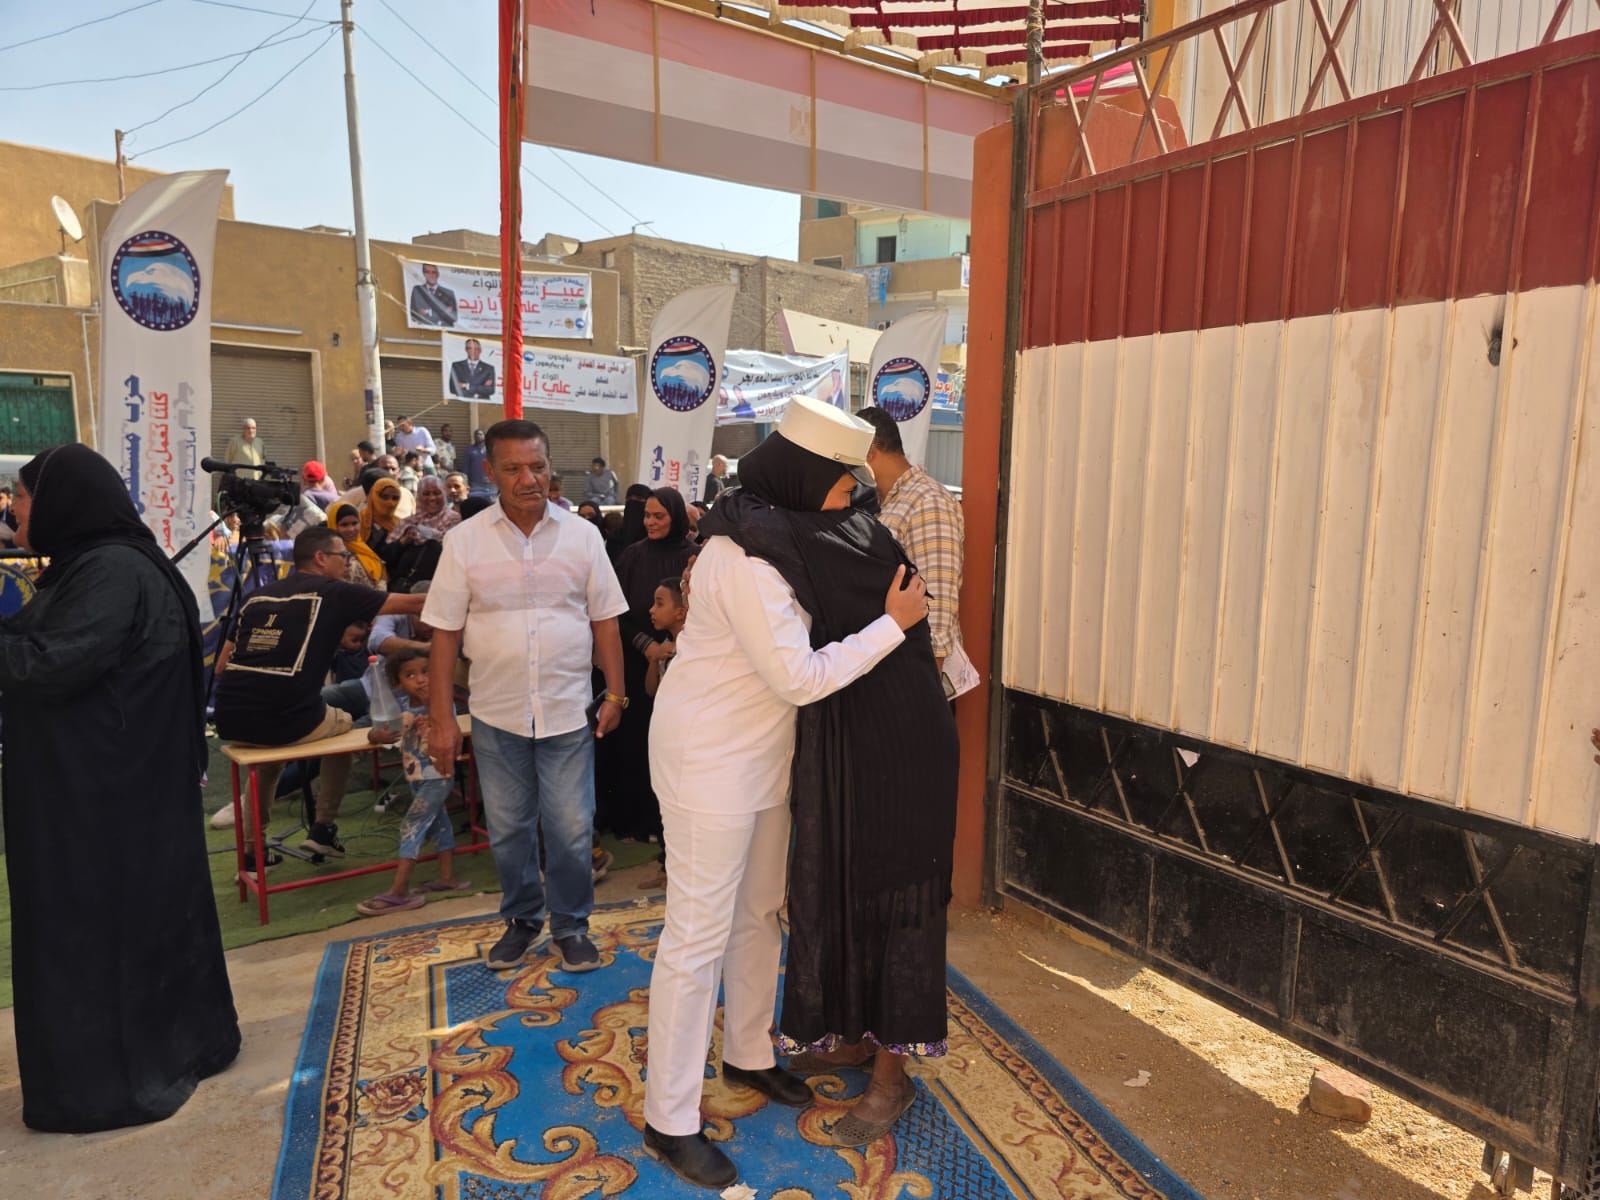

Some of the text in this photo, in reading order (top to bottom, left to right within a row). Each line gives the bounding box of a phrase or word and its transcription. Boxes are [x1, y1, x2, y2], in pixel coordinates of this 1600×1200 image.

[458, 295, 484, 314] زيد
[540, 285, 585, 302] عبير
[123, 374, 145, 423] حزب
[542, 380, 571, 397] علي
[153, 391, 169, 420] كلنا
[154, 423, 172, 462] نعمل
[157, 463, 175, 485] من
[652, 445, 664, 481] حزب
[161, 518, 175, 554] مصر
